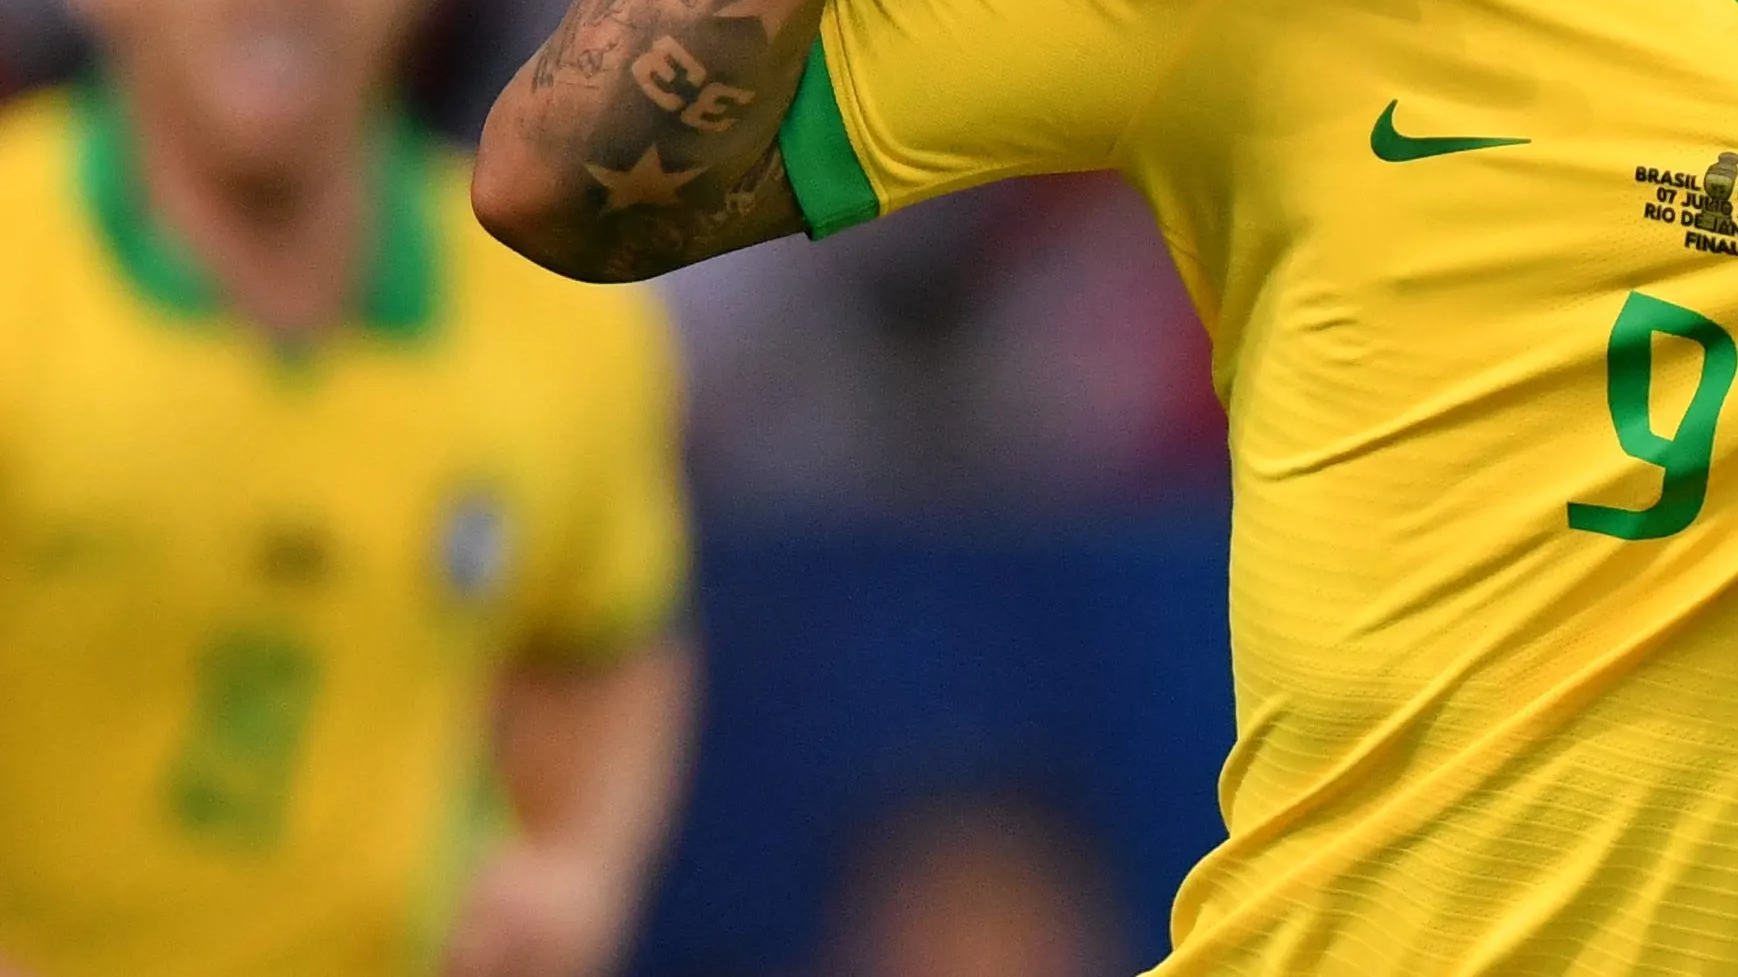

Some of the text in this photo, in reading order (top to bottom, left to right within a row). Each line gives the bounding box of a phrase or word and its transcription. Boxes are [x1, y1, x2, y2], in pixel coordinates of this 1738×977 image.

[1635, 166, 1701, 191] BRASIL
[1656, 187, 1677, 205] 07
[1644, 202, 1676, 223] RIO
[1681, 209, 1704, 230] DE
[1567, 290, 1738, 541] 9
